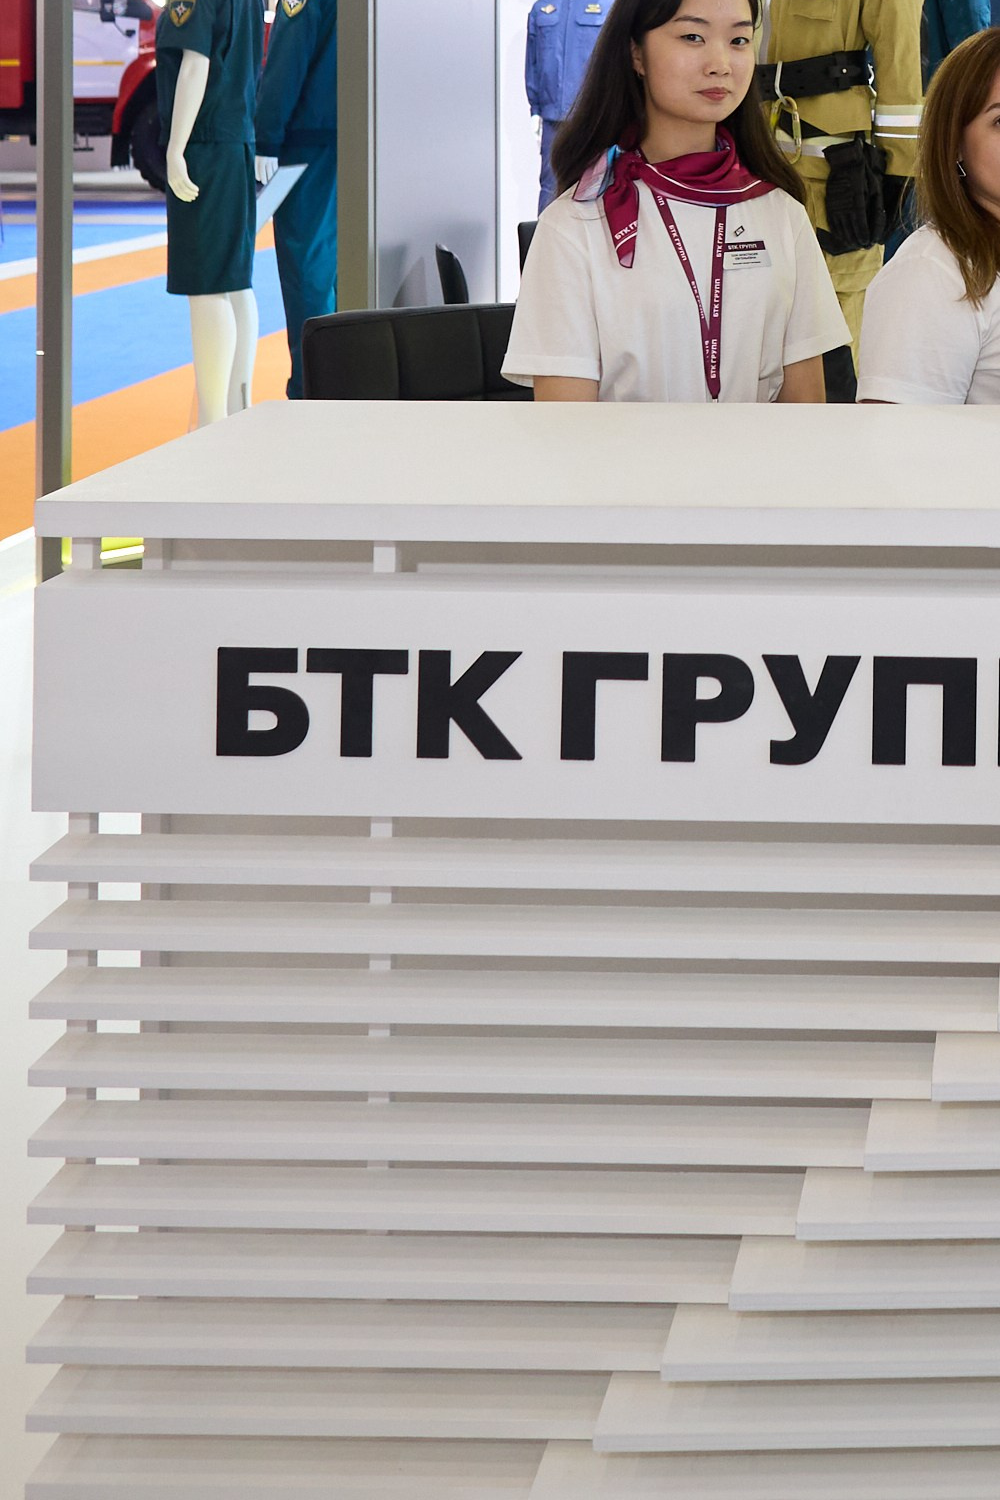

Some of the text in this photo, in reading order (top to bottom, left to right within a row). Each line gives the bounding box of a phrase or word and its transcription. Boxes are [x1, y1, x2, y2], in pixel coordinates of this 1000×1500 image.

[614, 226, 631, 240] БТК
[668, 224, 688, 261] БТК ГРУПП
[717, 222, 725, 245] ГРУПП
[713, 278, 721, 303] ГРУПП
[710, 339, 718, 364] ГРУПП
[214, 645, 524, 761] БТК
